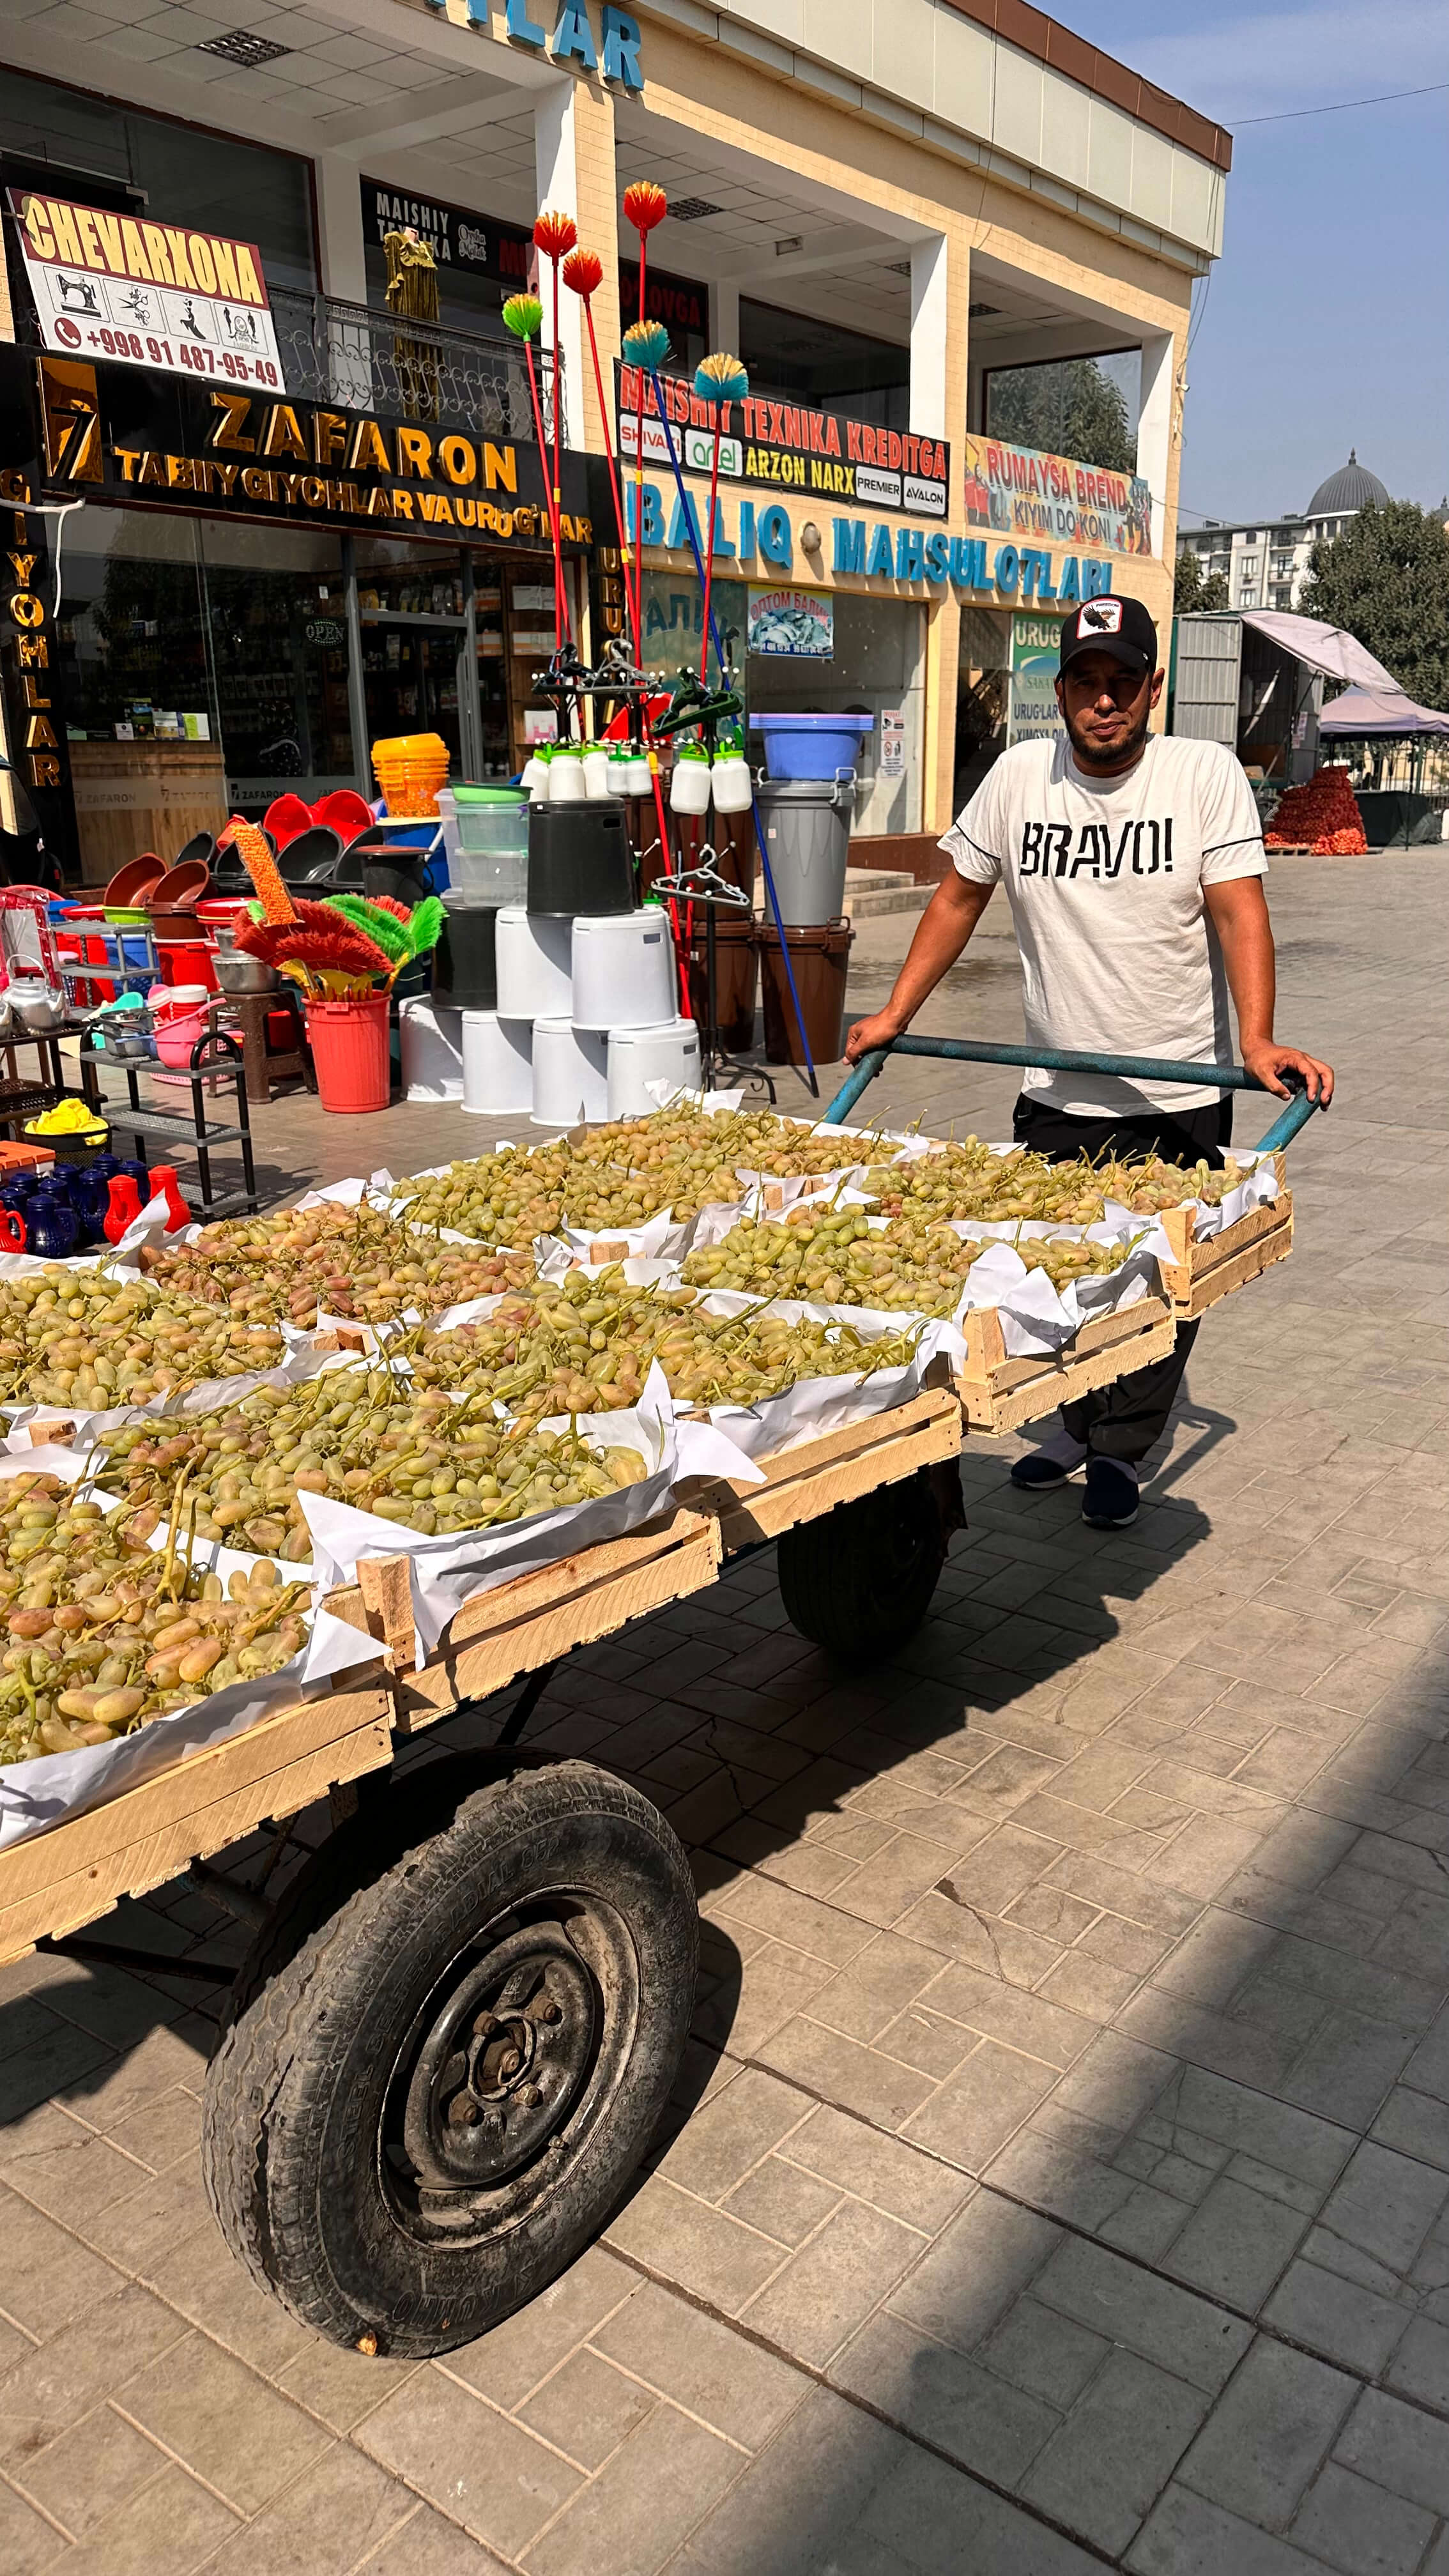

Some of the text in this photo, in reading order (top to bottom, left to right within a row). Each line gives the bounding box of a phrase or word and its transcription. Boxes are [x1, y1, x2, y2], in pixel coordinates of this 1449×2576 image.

[377, 192, 448, 234] MAISHIY
[21, 195, 264, 305] CHEVARXONA
[87, 328, 144, 360] +998
[146, 337, 174, 365] 91
[180, 344, 278, 387] 487-95-49
[210, 392, 518, 493] ZAFARON
[741, 397, 841, 457] TEXNIKA
[847, 421, 946, 480] KREDITGA
[114, 446, 239, 496] TABIIY
[241, 467, 414, 520] GIYOHLAR
[416, 492, 454, 525] VA
[746, 447, 855, 496] ARZON NARX
[857, 477, 900, 496] PREMIER
[906, 486, 944, 505] AVALON
[986, 447, 1131, 514] RUMAYSA BREND
[626, 480, 1113, 606] BALIQ MAHSULOTLARI
[1014, 498, 1110, 544] KIYIM DO'KONI
[305, 624, 344, 640] OPEN
[751, 591, 790, 621] ОПТОМ
[1020, 818, 1173, 878] BRAVO!
